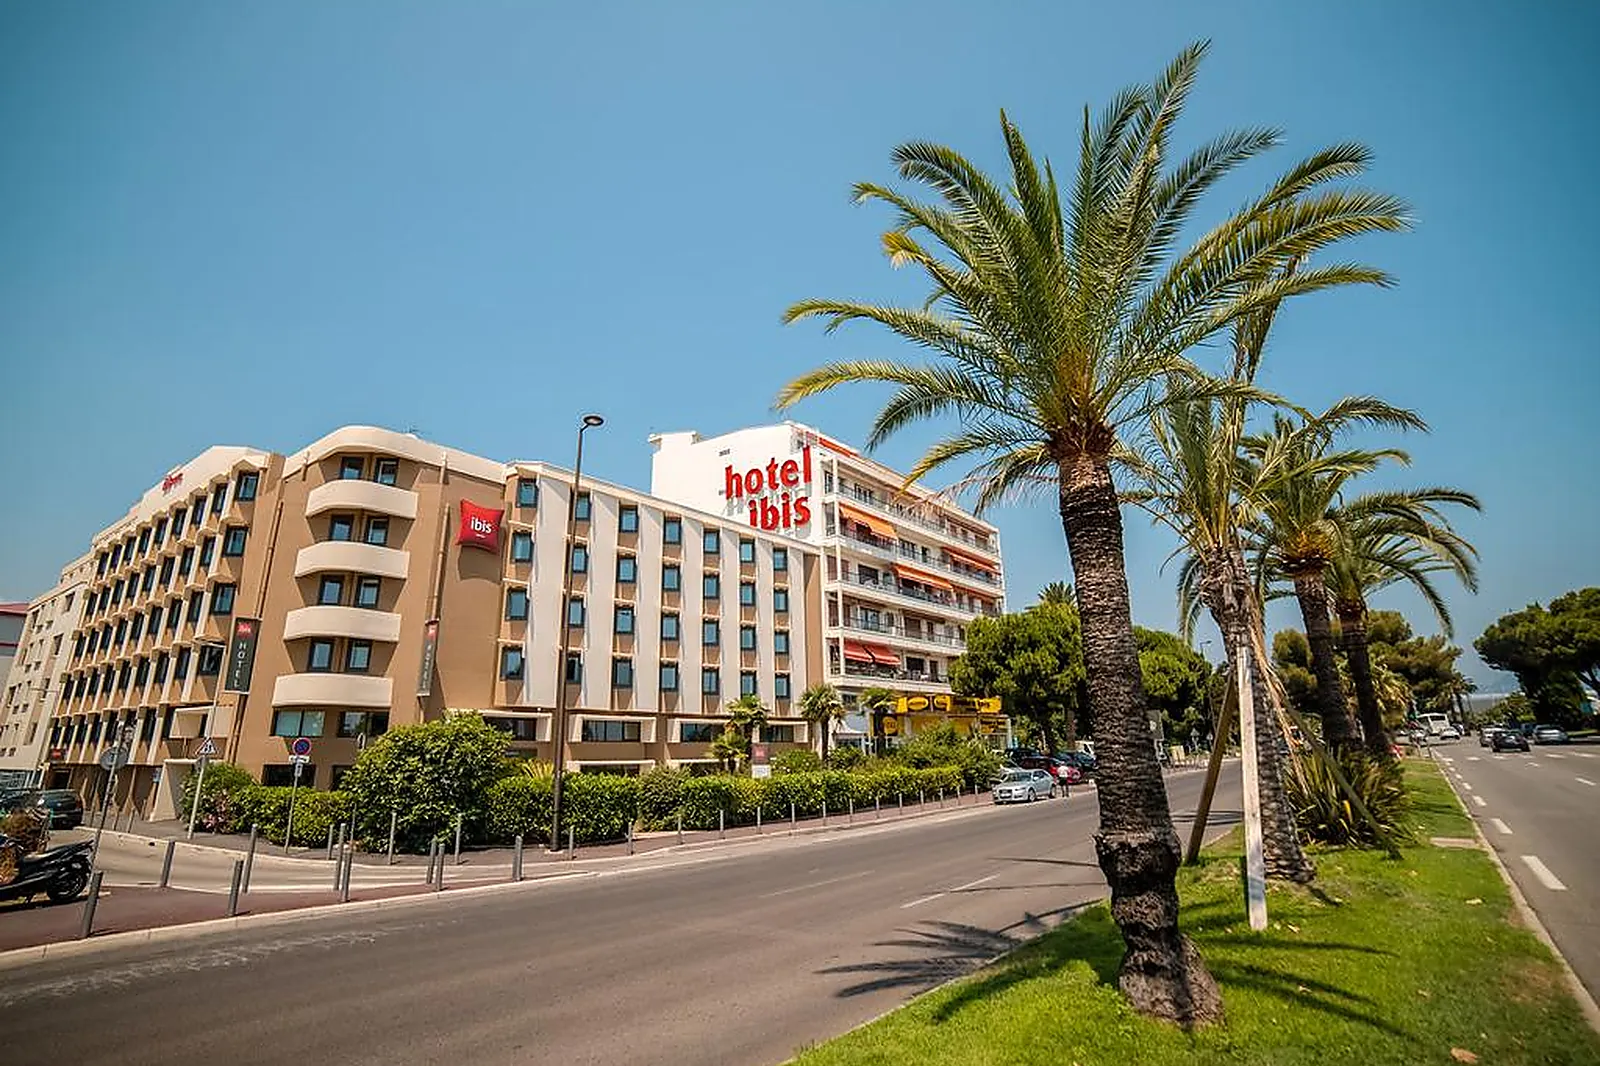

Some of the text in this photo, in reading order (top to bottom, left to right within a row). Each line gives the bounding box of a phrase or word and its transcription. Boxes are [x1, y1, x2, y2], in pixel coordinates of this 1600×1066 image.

[724, 445, 812, 500] hotel
[471, 516, 492, 534] ibis
[748, 492, 812, 531] ibis
[233, 641, 248, 688] HOTEL
